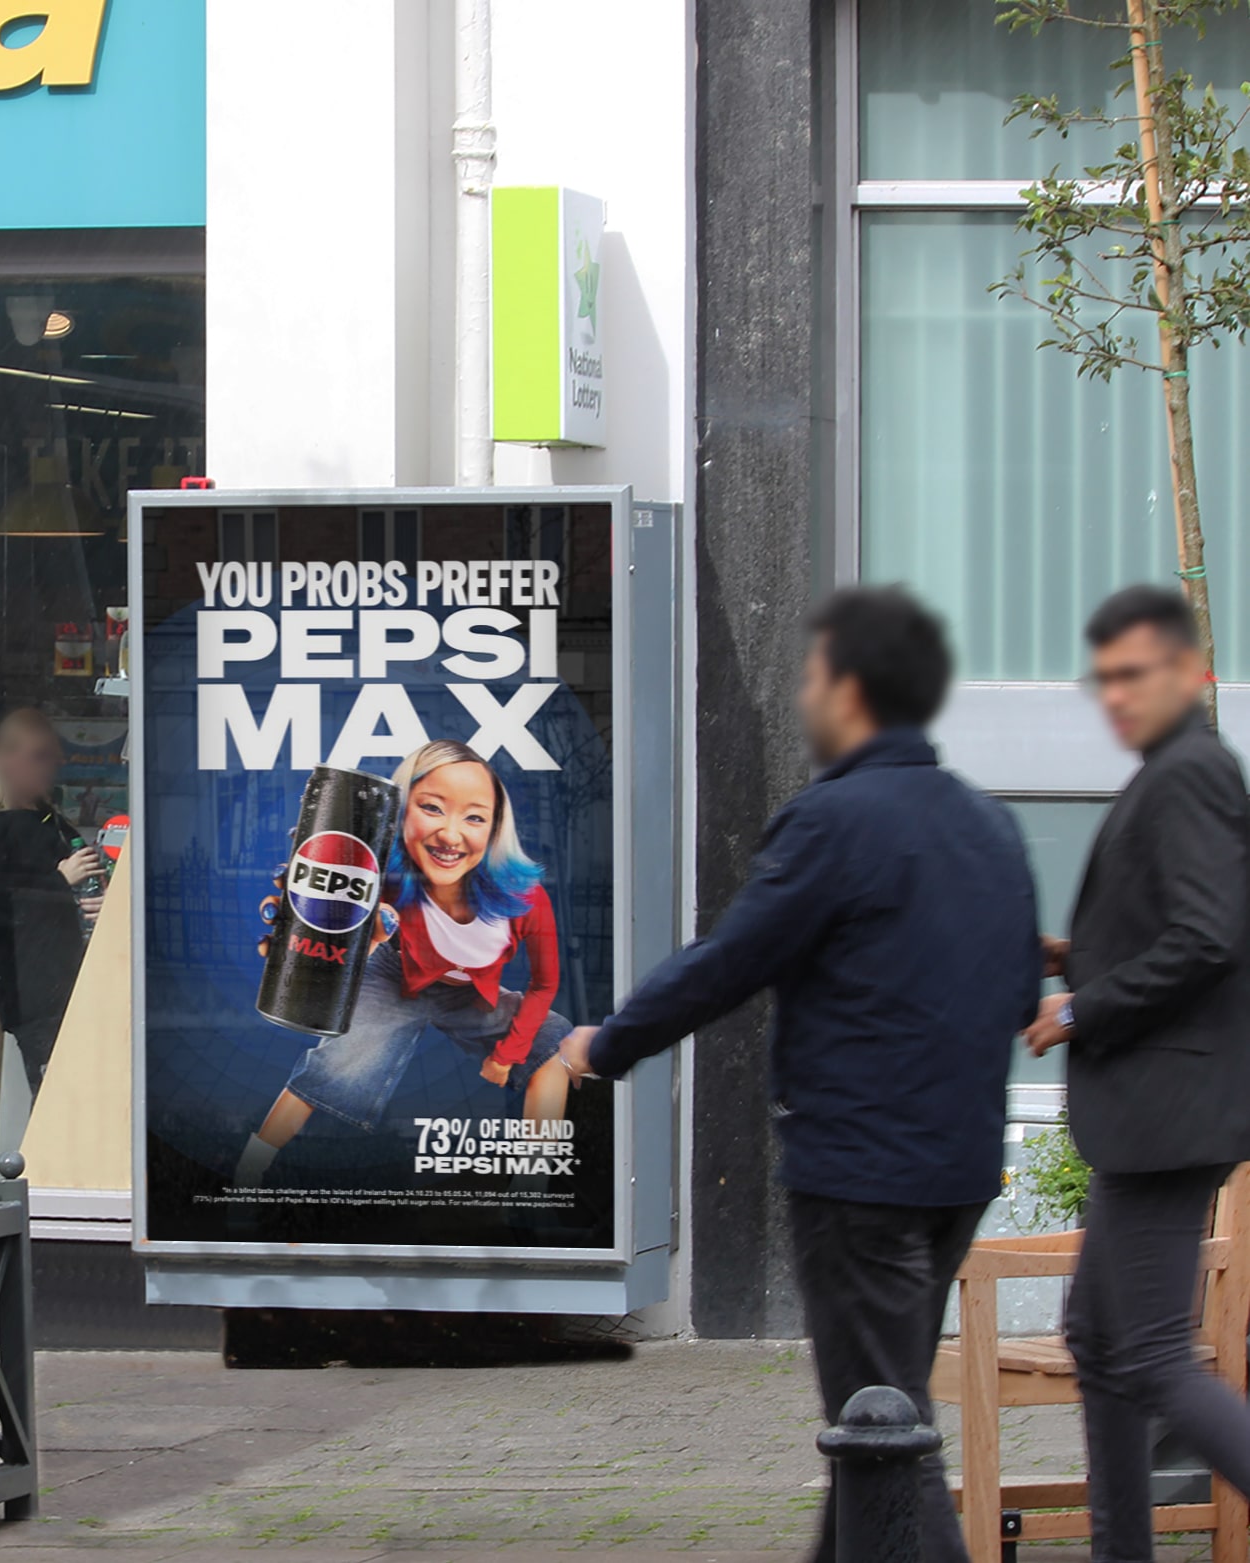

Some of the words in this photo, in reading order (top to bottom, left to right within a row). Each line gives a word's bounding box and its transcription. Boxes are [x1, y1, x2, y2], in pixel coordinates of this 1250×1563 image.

[569, 346, 602, 379] National
[572, 379, 602, 419] Lottery
[196, 560, 272, 607] YOU
[281, 560, 407, 607] PROBS
[416, 560, 559, 606] PREFER
[196, 607, 558, 680] PEPSI
[197, 683, 563, 770] MAX
[293, 862, 374, 903] PEPSI
[288, 934, 348, 965] MAX
[414, 1117, 477, 1155] 73%
[479, 1118, 501, 1139] OF
[504, 1118, 575, 1140] IRELAND
[480, 1141, 575, 1156] PREFER
[414, 1156, 500, 1174] PEPSI
